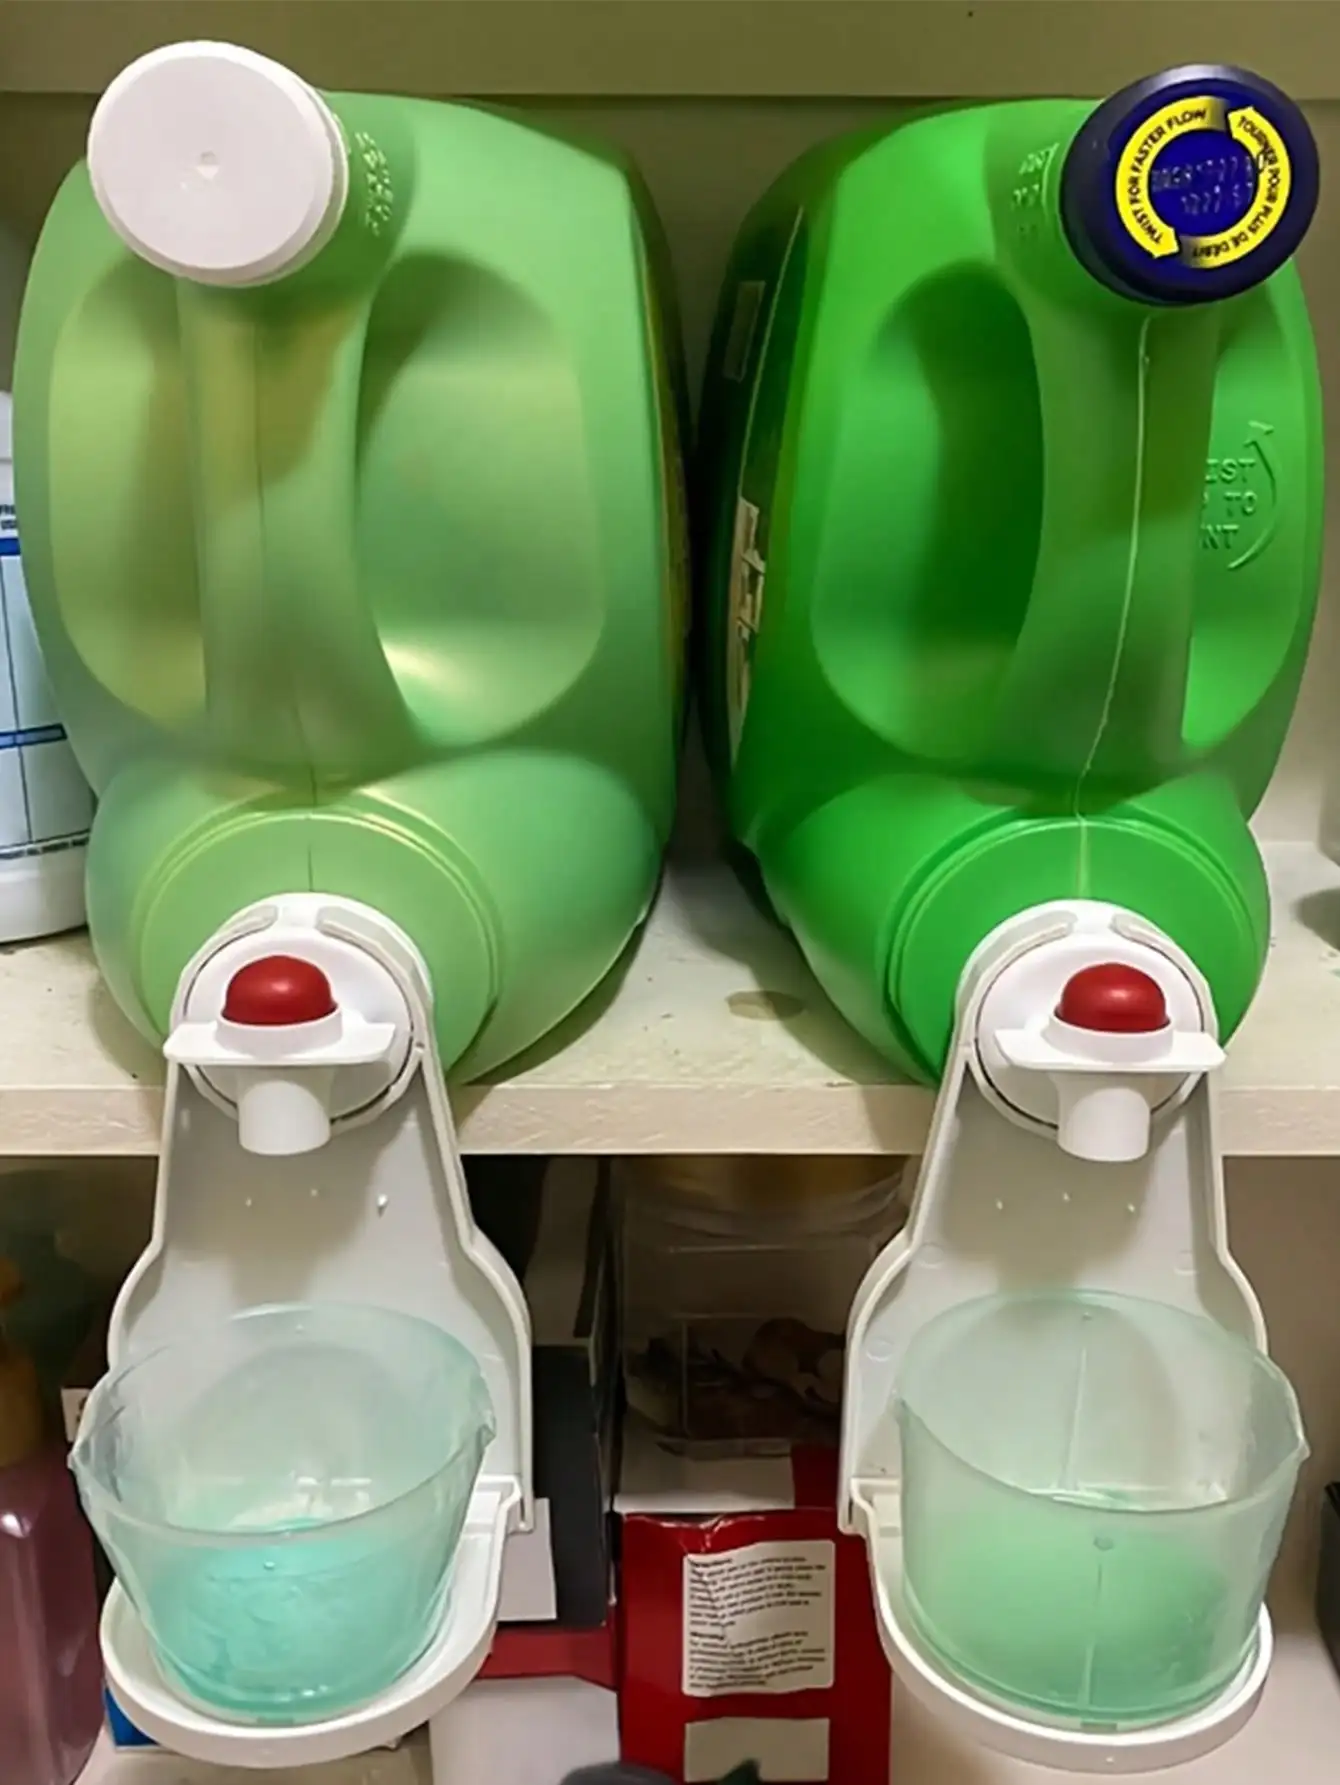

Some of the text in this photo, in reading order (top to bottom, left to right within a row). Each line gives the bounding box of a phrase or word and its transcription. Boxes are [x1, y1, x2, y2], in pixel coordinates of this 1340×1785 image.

[1237, 115, 1278, 165] TOURNER
[1128, 108, 1207, 244] TWIST FOR FASTER FLOW
[1267, 168, 1281, 204] POUR
[1249, 205, 1273, 234] PLUS
[1232, 232, 1249, 247] DE
[1201, 523, 1239, 550] NT
